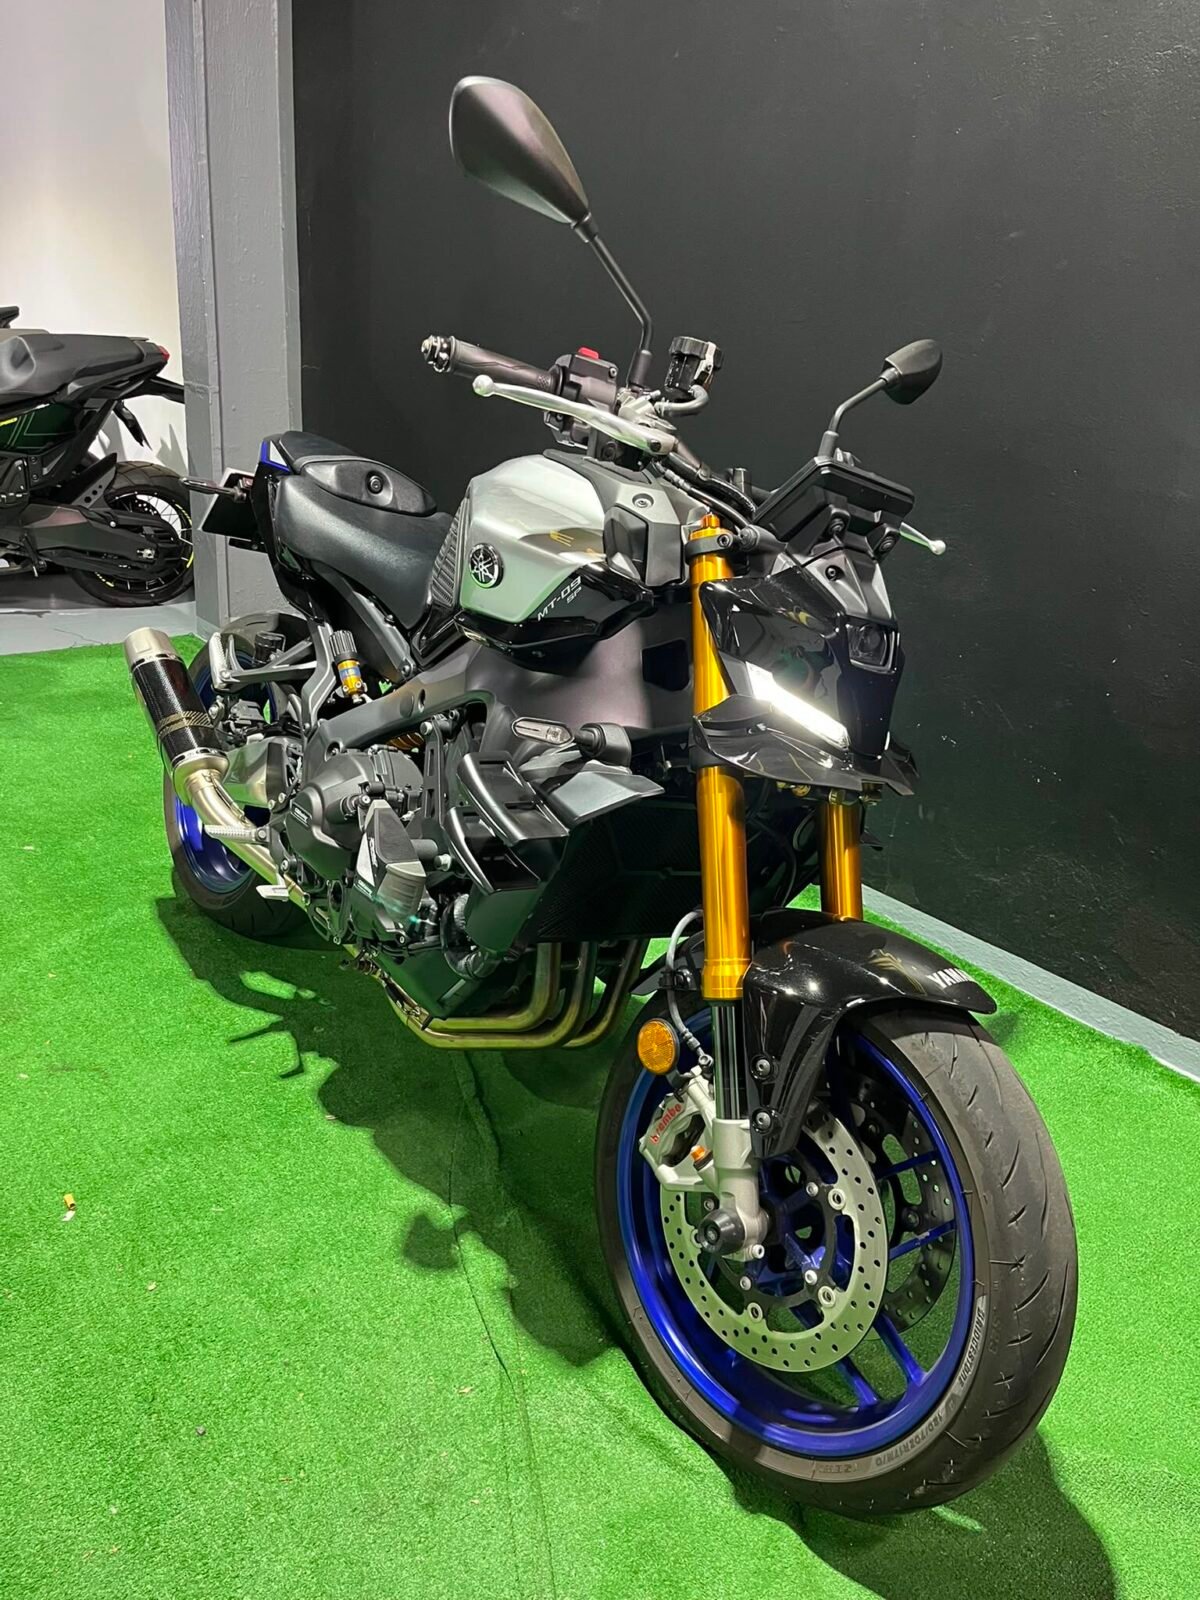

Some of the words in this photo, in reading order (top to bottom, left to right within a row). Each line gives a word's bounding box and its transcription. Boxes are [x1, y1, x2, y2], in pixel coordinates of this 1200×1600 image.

[537, 575, 581, 621] MT-09
[566, 586, 582, 604] SP
[650, 1103, 682, 1144] brembo
